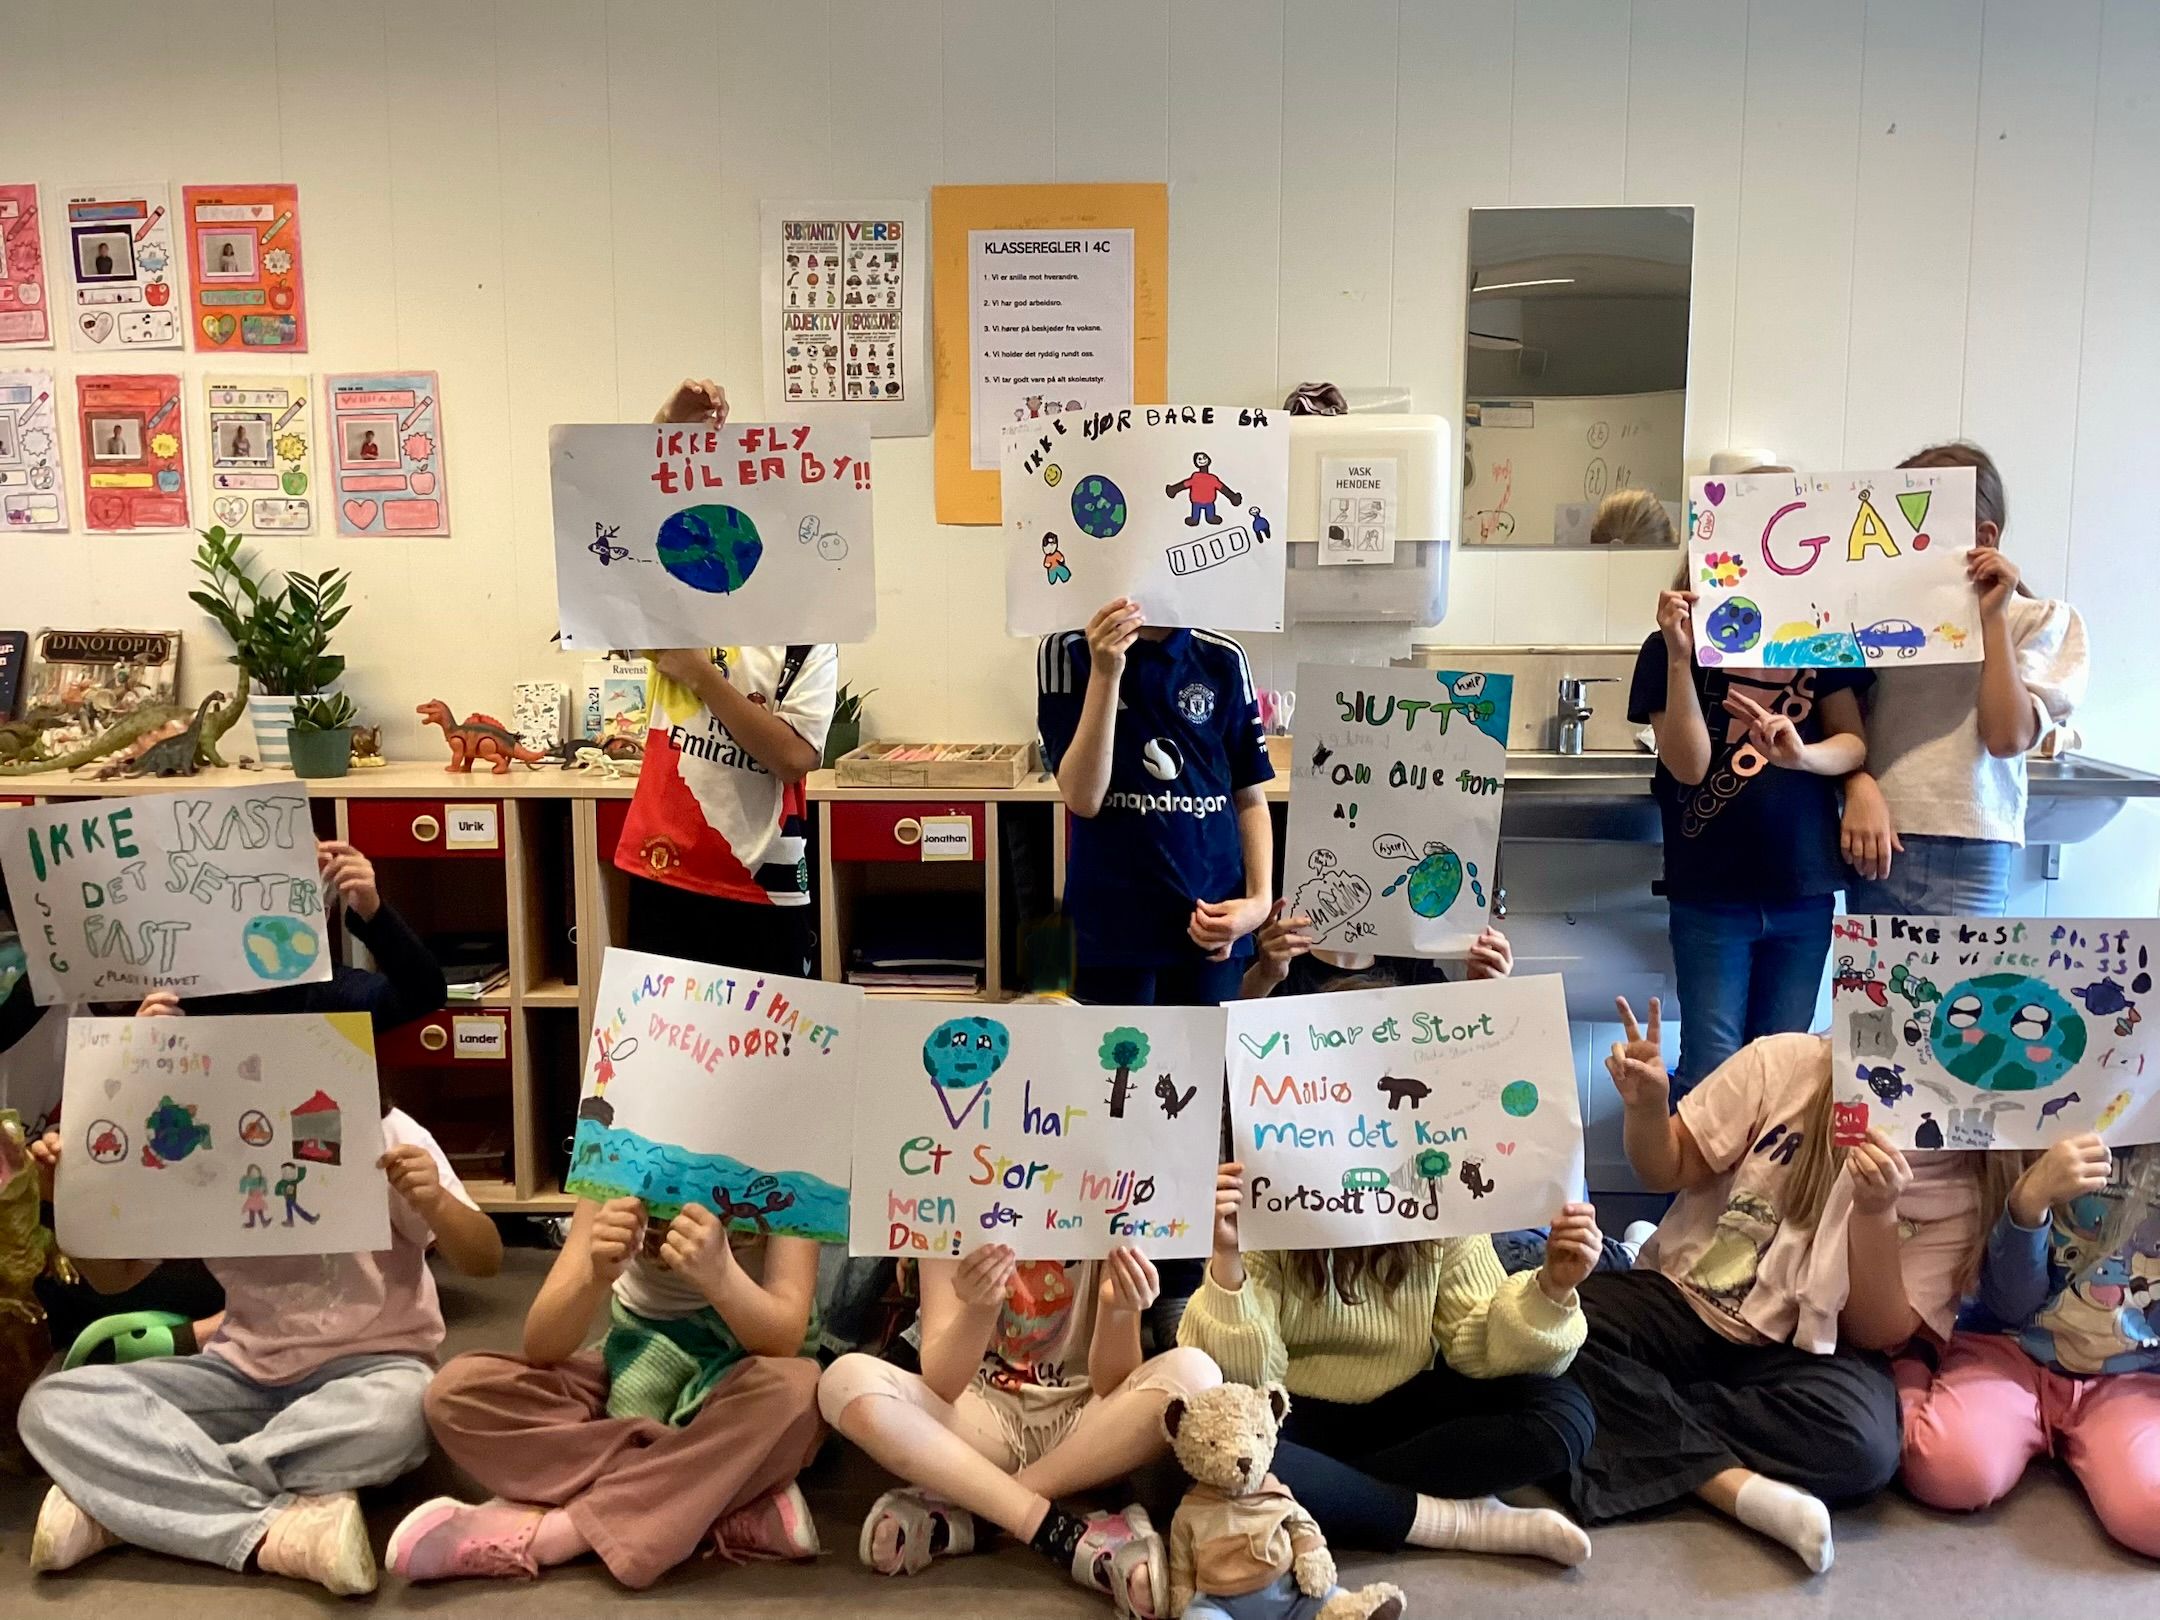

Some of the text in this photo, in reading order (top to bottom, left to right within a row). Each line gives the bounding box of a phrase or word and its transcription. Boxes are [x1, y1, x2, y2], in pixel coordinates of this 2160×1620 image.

[785, 223, 841, 240] SUBSTANTIV
[845, 221, 901, 240] VERB
[985, 241, 1111, 254] KLASSEREGLER I 4C
[1014, 300, 1027, 309] god
[785, 313, 839, 331] ADJEKTIV
[1021, 324, 1030, 334] på
[1031, 325, 1064, 334] beskjeder
[1037, 351, 1060, 360] ryddig
[1013, 376, 1029, 385] godt
[1047, 375, 1056, 385] på
[1068, 376, 1106, 385] skoleutstyr.
[1023, 418, 1067, 474] IKKE
[1083, 410, 1131, 441] KJØR
[1147, 406, 1214, 427] BARE
[1349, 467, 1371, 476] VASK
[1336, 480, 1381, 489] HENDENE
[1761, 488, 1932, 576] GÅ!
[52, 635, 164, 653] DINOTOPIA
[588, 687, 599, 712] 2x24
[458, 821, 485, 832] Ulrik
[28, 796, 305, 882] IKKE KAST
[924, 833, 968, 844] Jonathan
[82, 850, 323, 916] DET SETTER
[83, 914, 191, 974] FAST
[1959, 951, 1980, 966] vi
[153, 975, 200, 988] HAVET
[632, 973, 675, 1006] KAST
[684, 976, 736, 1006] PLAST
[459, 1033, 498, 1044] Lander
[648, 1013, 793, 1074] DYRENE DØR!
[1239, 1011, 1495, 1059] Vi har et Stort
[1250, 1074, 1352, 1106] Miljø
[931, 1076, 1088, 1137] Vi har
[1348, 1114, 1398, 1148] det
[899, 1136, 1156, 1214] et Stort miljø
